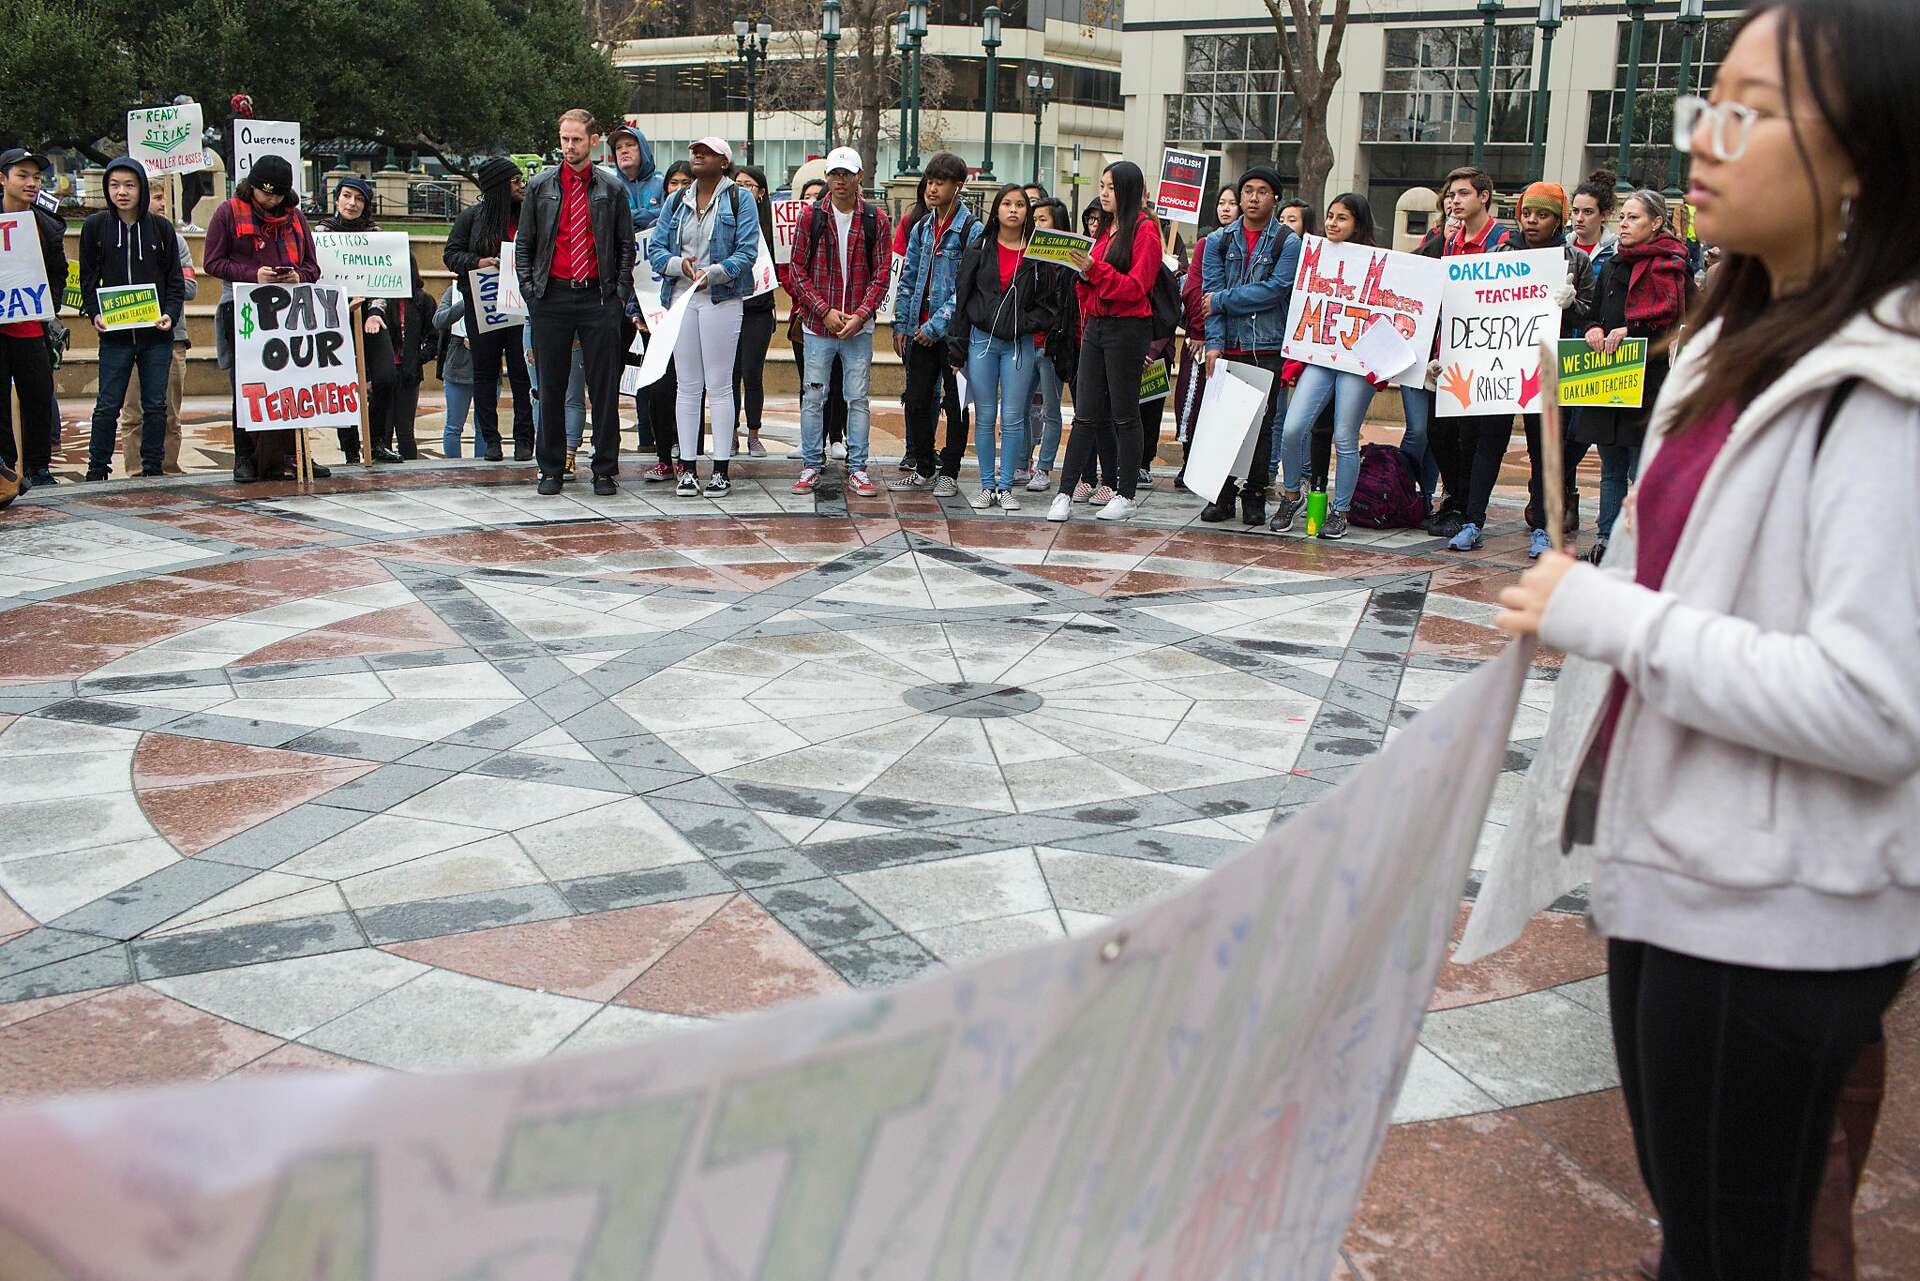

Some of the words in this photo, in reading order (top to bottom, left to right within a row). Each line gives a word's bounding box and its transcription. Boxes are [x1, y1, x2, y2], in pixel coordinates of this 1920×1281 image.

[146, 108, 179, 122] READY
[145, 123, 191, 142] STRIKE
[241, 127, 296, 145] Queremos
[145, 154, 177, 171] SMALLER
[178, 152, 202, 166] CLASSES
[1168, 155, 1202, 169] ABOLISH
[1159, 195, 1197, 209] SCHOOLS!
[315, 233, 369, 248] AESTROS
[1046, 237, 1069, 247] STAND
[1069, 239, 1089, 250] WITH
[342, 253, 393, 267] FAMILIAS
[1449, 261, 1532, 281] OAKLAND
[367, 274, 404, 289] LUCHA
[103, 299, 115, 310] WE
[115, 293, 135, 307] STAND
[135, 289, 153, 302] WITH
[476, 272, 509, 325] READY
[1475, 284, 1549, 304] TEACHERS
[250, 284, 340, 330] PAY
[1450, 313, 1550, 350] DESERVE
[262, 330, 345, 371] OUR
[1563, 353, 1581, 374] WE
[1583, 347, 1613, 370] STAND
[1615, 341, 1640, 364] WITH
[1490, 356, 1504, 371] A
[1476, 375, 1517, 403] RAISE
[1563, 380, 1600, 400] OAKLAND
[1602, 373, 1639, 393] TEACHERS
